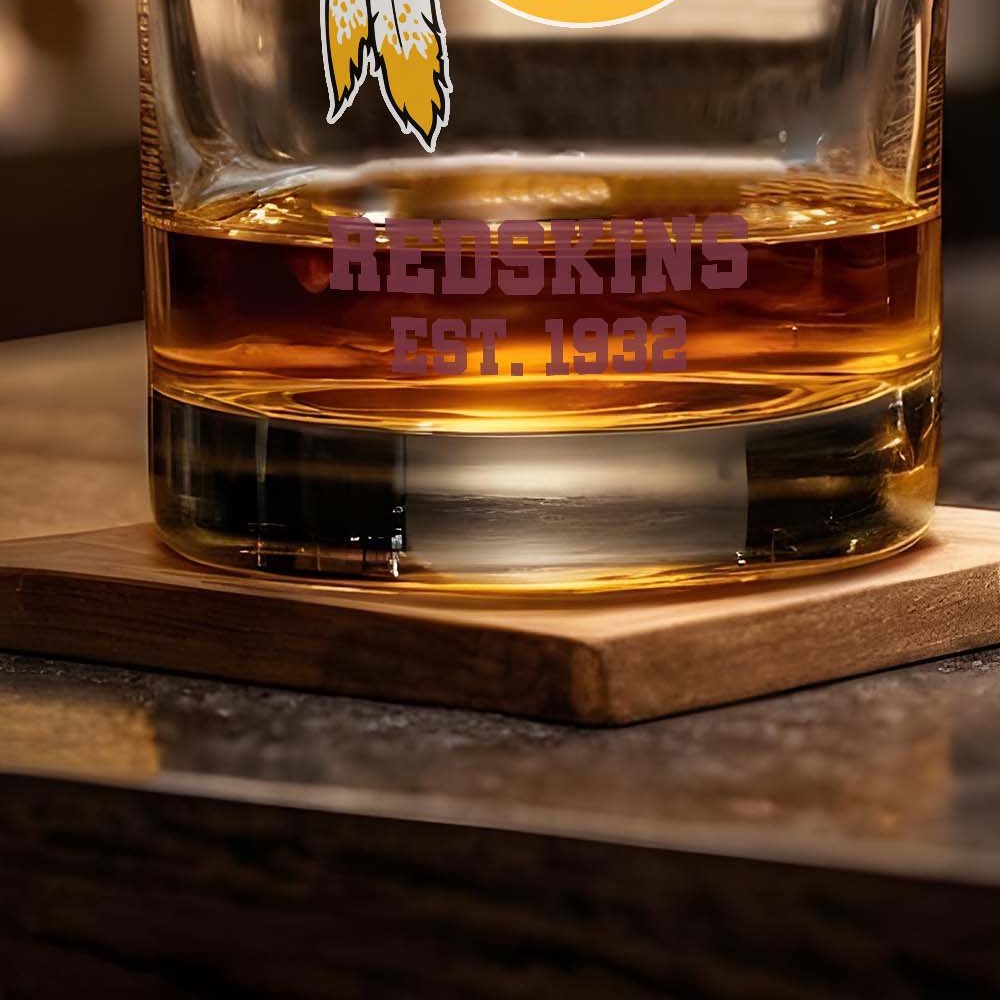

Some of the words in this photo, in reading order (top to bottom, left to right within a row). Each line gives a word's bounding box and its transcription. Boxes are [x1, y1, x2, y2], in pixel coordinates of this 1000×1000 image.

[328, 214, 749, 296] REDSKINS
[390, 316, 524, 376] EST.
[545, 315, 687, 376] 1932
